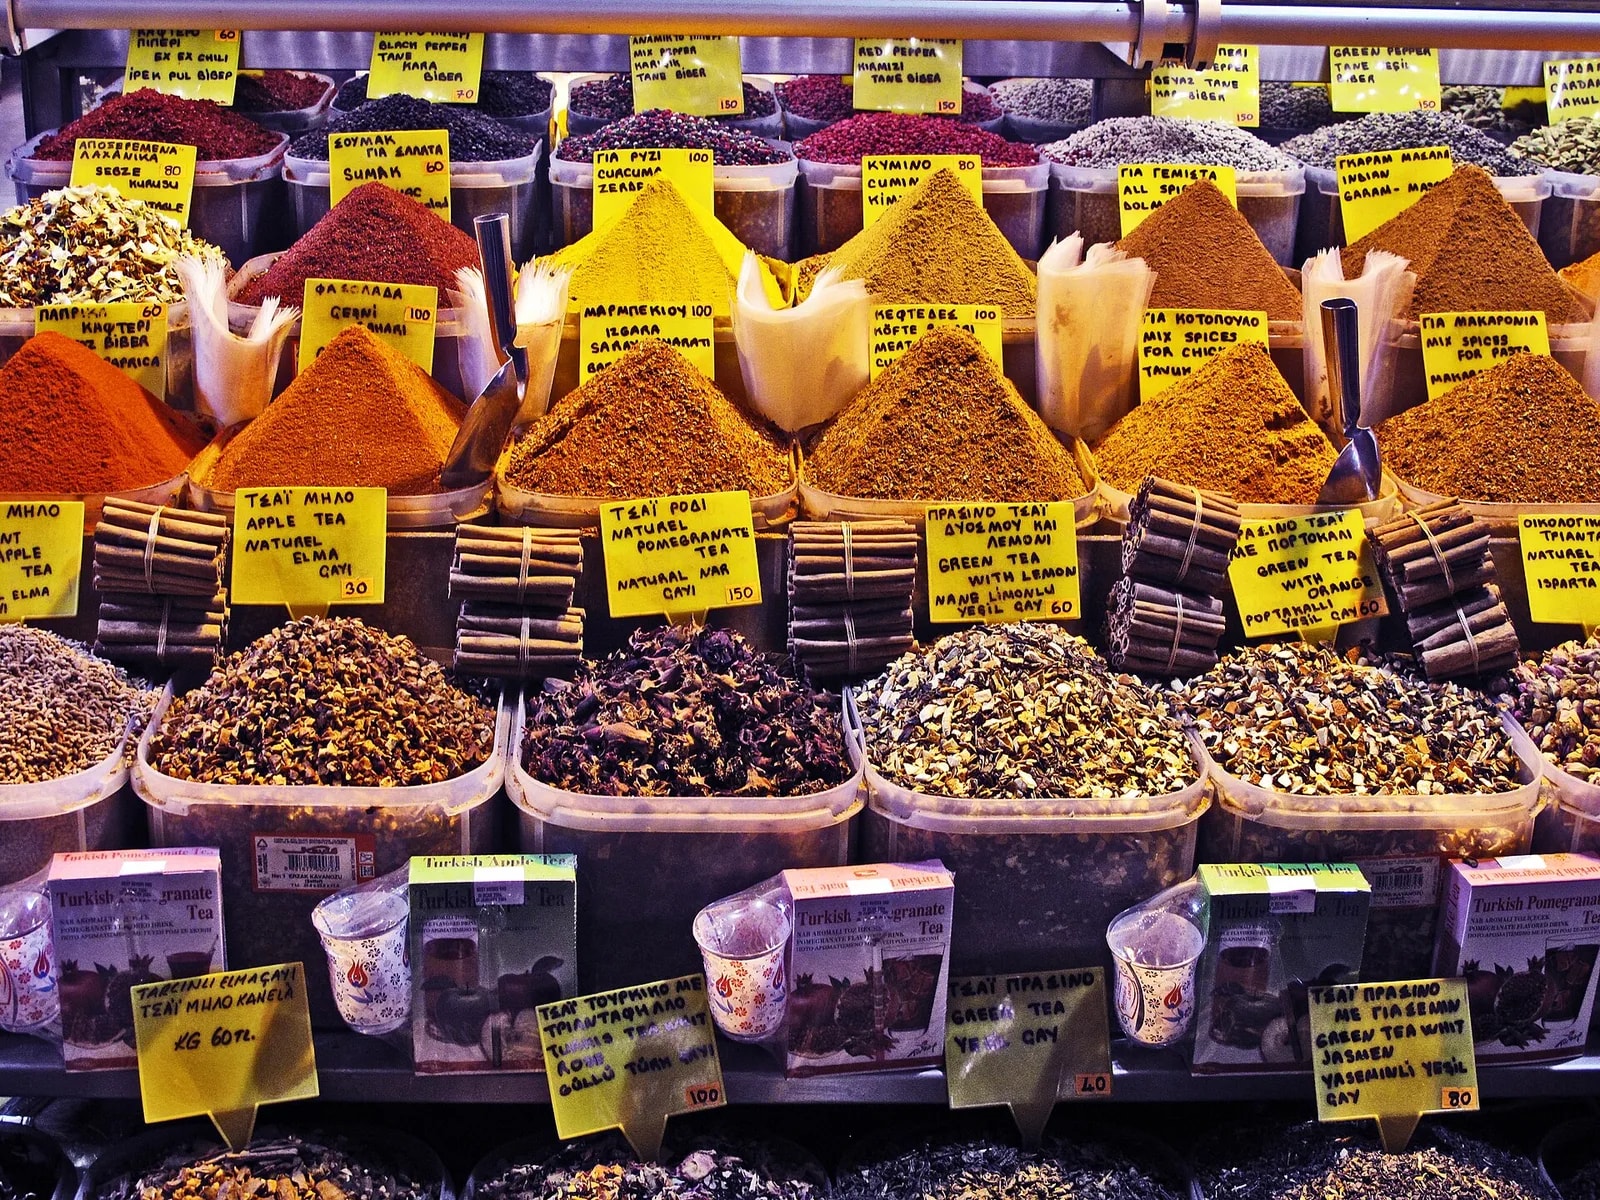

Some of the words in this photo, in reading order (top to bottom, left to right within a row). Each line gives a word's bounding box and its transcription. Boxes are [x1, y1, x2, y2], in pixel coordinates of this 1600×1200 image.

[220, 30, 235, 39] 60
[379, 41, 417, 50] BLACK
[859, 47, 883, 57] RED
[1334, 47, 1380, 58] GREEN
[198, 54, 228, 63] CHILI
[378, 52, 412, 62] TANE
[634, 49, 653, 58] MIX
[402, 62, 437, 71] KARA
[1335, 61, 1369, 72] TANE
[169, 71, 191, 81] PUL
[637, 72, 666, 82] TANE
[871, 73, 903, 84] TANE
[1204, 79, 1239, 89] TANE
[457, 89, 473, 98] 70
[721, 100, 738, 109] 150
[939, 101, 956, 110] 150
[1419, 100, 1436, 109] 150
[366, 147, 387, 157] ΓΙΑ
[598, 152, 619, 164] ΓΙΑ
[689, 152, 709, 162] 100
[95, 167, 141, 177] SEBZE
[164, 165, 181, 176] 80
[426, 161, 444, 173] 60
[959, 160, 975, 170] 80
[343, 166, 401, 181] SUMAK
[1121, 167, 1143, 178] ΓΙΑ
[1342, 169, 1390, 185] INDIAN
[868, 177, 919, 188] CUMIN
[1123, 184, 1151, 195] ALL
[142, 303, 162, 318] 60
[410, 307, 431, 320] 100
[692, 305, 713, 317] 100
[975, 309, 997, 320] 100
[873, 323, 918, 337] KÖFTE
[1422, 317, 1445, 329] ΓΙΑ
[605, 324, 661, 338] IZGARA
[1143, 331, 1172, 343] MIX
[1184, 331, 1237, 344] SPICES
[1426, 335, 1452, 348] MIX
[1462, 334, 1509, 348] SPICES
[1143, 346, 1174, 358] FOR
[1457, 349, 1483, 362] FOR
[304, 491, 356, 506] ΜΗΛΟ
[6, 503, 61, 519] ΜΗΛΟ
[669, 498, 708, 516] ΡΟΔΙ
[928, 506, 997, 521] ΠΡΑΣΙΝΟ
[246, 515, 297, 530] APPLE
[313, 512, 346, 526] TEA
[1033, 519, 1058, 532] ΚΑΙ
[611, 520, 689, 542] NATUREL
[245, 536, 324, 553] NATUREL
[636, 526, 751, 554] POMEGRANATE
[986, 534, 1052, 550] ΛΕΜΟΝΙ
[292, 547, 340, 565] ELMA
[694, 543, 731, 560] TEA
[1229, 543, 1259, 562] ΜΕ
[1527, 548, 1595, 561] NATUREL
[938, 555, 994, 574] GREEN
[1006, 551, 1041, 566] TEA
[1256, 557, 1310, 578] GREEN
[1321, 550, 1358, 565] TEA
[1569, 561, 1600, 573] TEA
[21, 563, 53, 578] TEA
[617, 570, 689, 592] NATURAL
[700, 563, 731, 581] NAR
[967, 571, 1016, 587] WITH
[1021, 566, 1078, 582] LEMON
[345, 581, 368, 595] 30
[1280, 572, 1325, 592] WITH
[1307, 575, 1375, 600] ORANGE
[1537, 577, 1597, 590] ISPARTA
[12, 586, 50, 601] ELMA
[729, 587, 754, 601] 150
[935, 591, 980, 607] NANE
[1051, 601, 1074, 615] 60
[1360, 600, 1380, 616] 60
[423, 857, 484, 869] Turkish
[1213, 865, 1272, 878] Turkish
[186, 904, 214, 920] Tea
[1474, 896, 1524, 914] Turkish
[798, 908, 852, 927] Turkish
[919, 920, 944, 936] Tea
[1363, 982, 1442, 1003] ΠΡΑΣΙΝΟ
[1027, 1000, 1066, 1017] TEA
[1334, 1007, 1362, 1022] ΜΕ
[174, 1031, 202, 1051] KG
[1315, 1028, 1376, 1049] GREEN
[1380, 1023, 1418, 1041] TEA
[1321, 1045, 1395, 1066] JASMEN
[1080, 1076, 1107, 1092] 40
[689, 1088, 719, 1105] 100
[1447, 1090, 1473, 1107] 80
